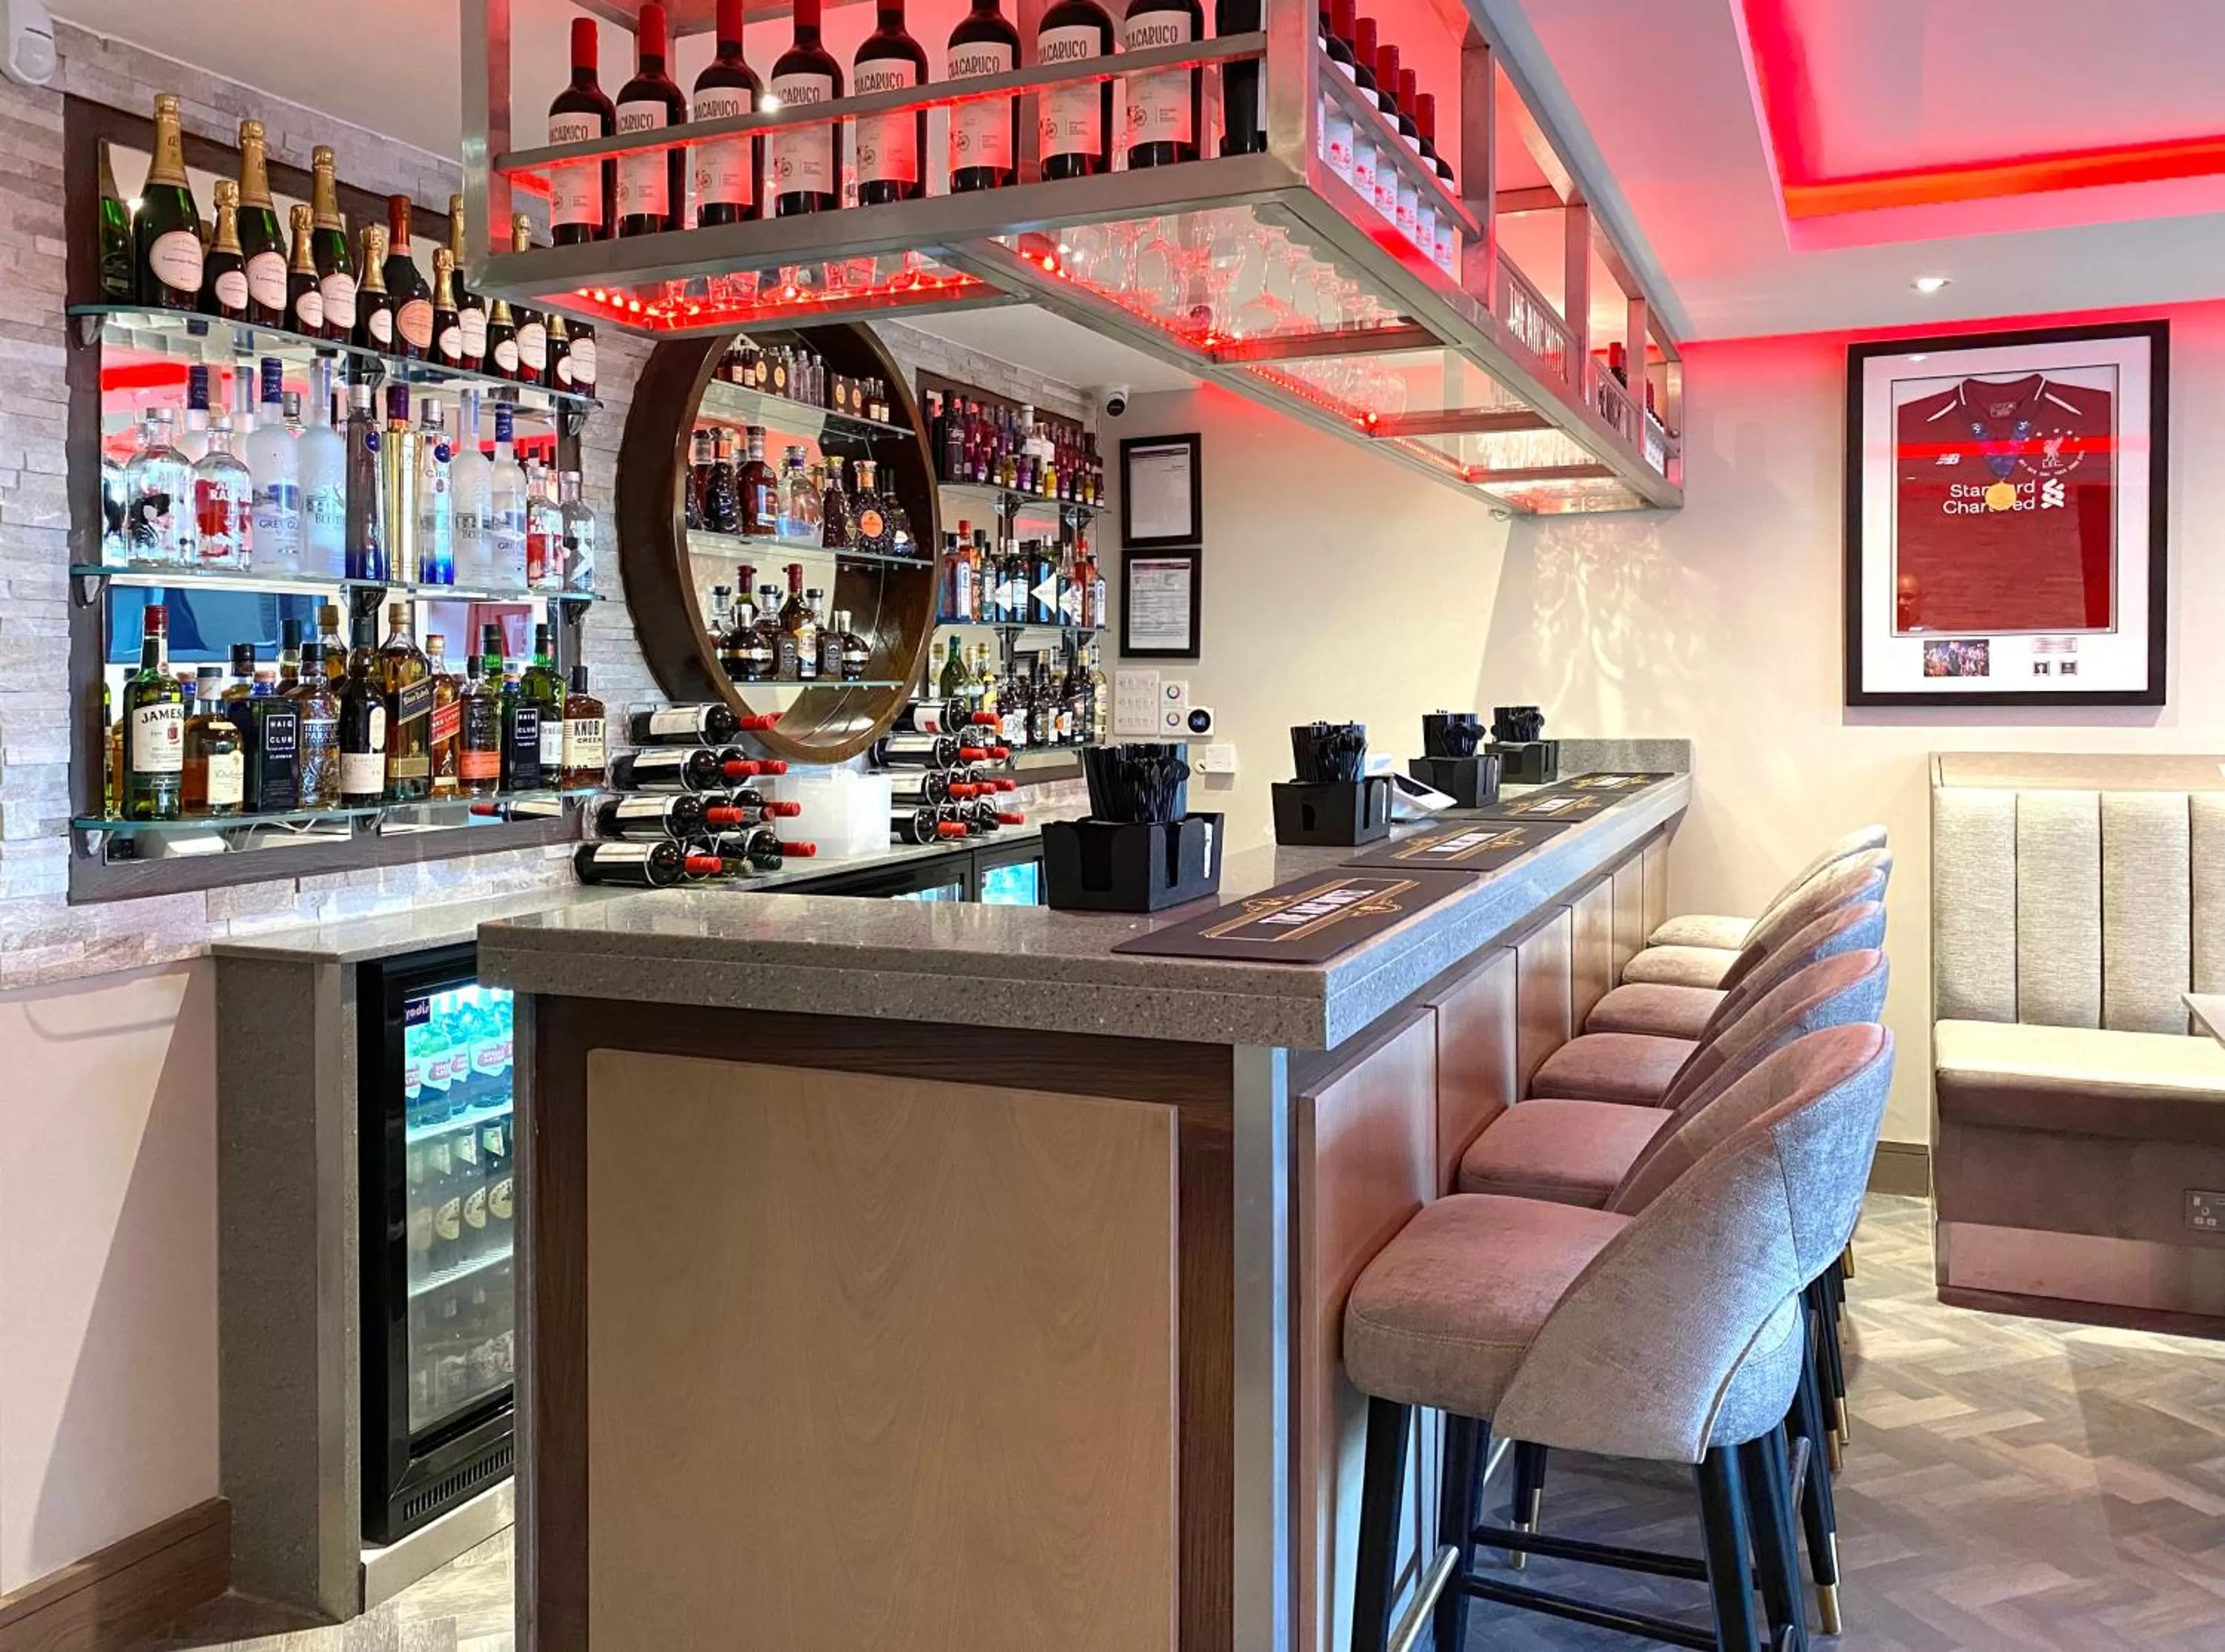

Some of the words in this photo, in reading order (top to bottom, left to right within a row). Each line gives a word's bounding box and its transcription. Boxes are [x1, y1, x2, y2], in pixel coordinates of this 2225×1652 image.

[1950, 479, 2035, 498] Stard
[1942, 496, 2035, 514] Chared
[574, 720, 600, 736] KNOB
[269, 736, 293, 744] CLUB
